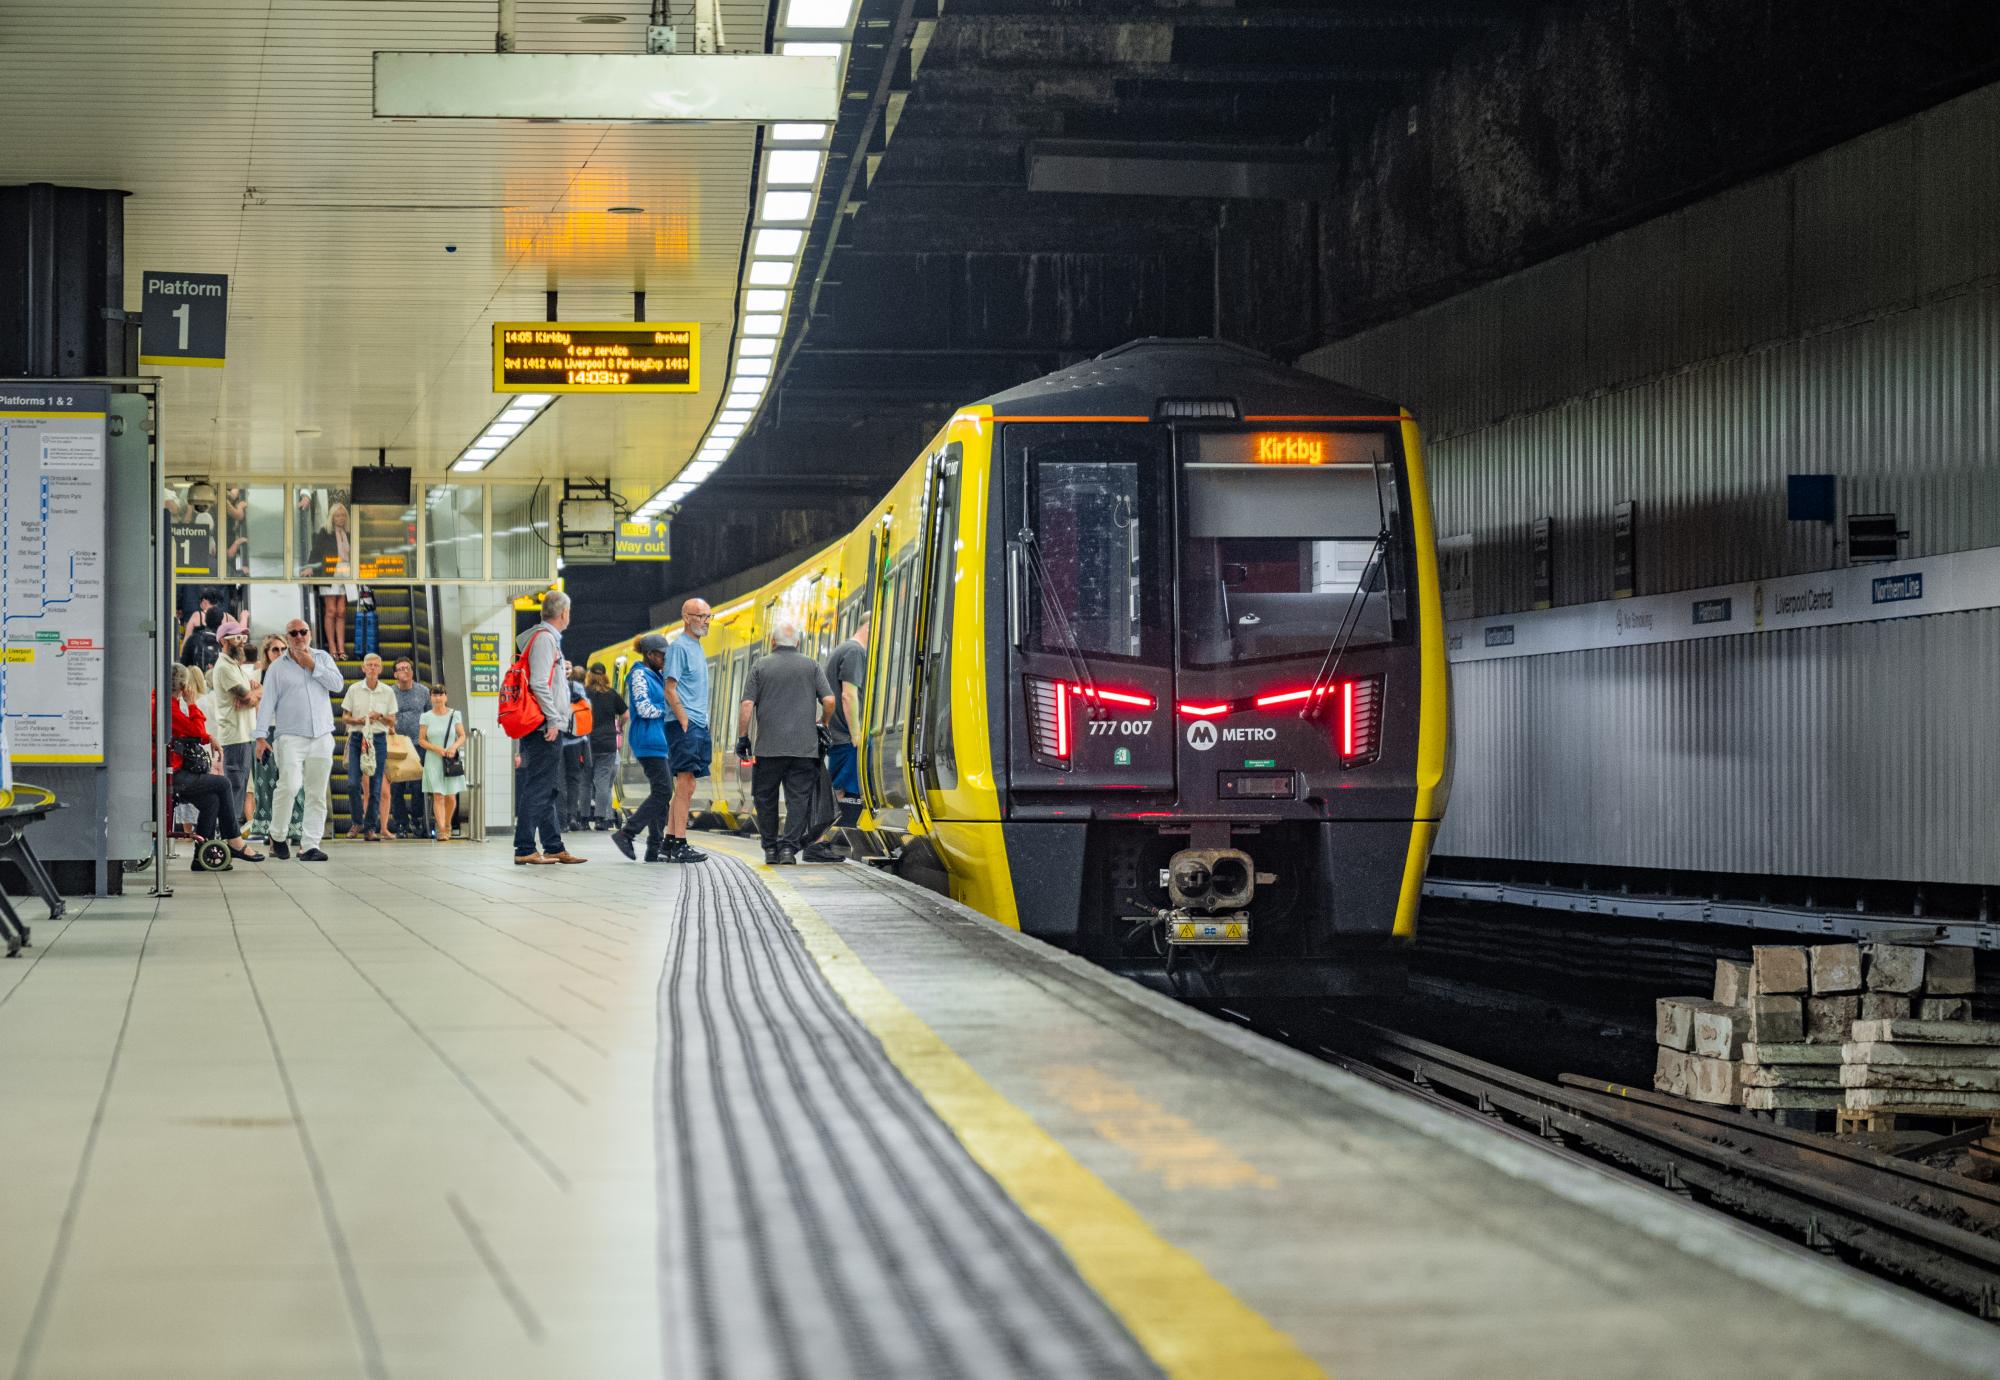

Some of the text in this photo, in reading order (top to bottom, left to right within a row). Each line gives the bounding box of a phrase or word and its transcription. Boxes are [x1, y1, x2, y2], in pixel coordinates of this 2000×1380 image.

[148, 279, 222, 297] Platform
[172, 303, 190, 350] 1
[505, 331, 689, 346] 14:05 Kirkby Arrived
[567, 344, 629, 357] 4 car service
[504, 357, 521, 370] 3rd
[523, 357, 546, 370] 1412
[547, 357, 563, 370] via
[564, 357, 606, 371] Liverpool
[567, 370, 630, 385] 14:03:17
[0, 396, 73, 406] Platforms 1 & 2
[1260, 437, 1321, 464] Kirkby
[180, 539, 190, 565] 1
[615, 540, 665, 554] Way out
[1775, 586, 1834, 617] Liverpool Central
[472, 634, 487, 642] Way
[1088, 720, 1153, 736] 777 007
[1222, 727, 1277, 741] METRO
